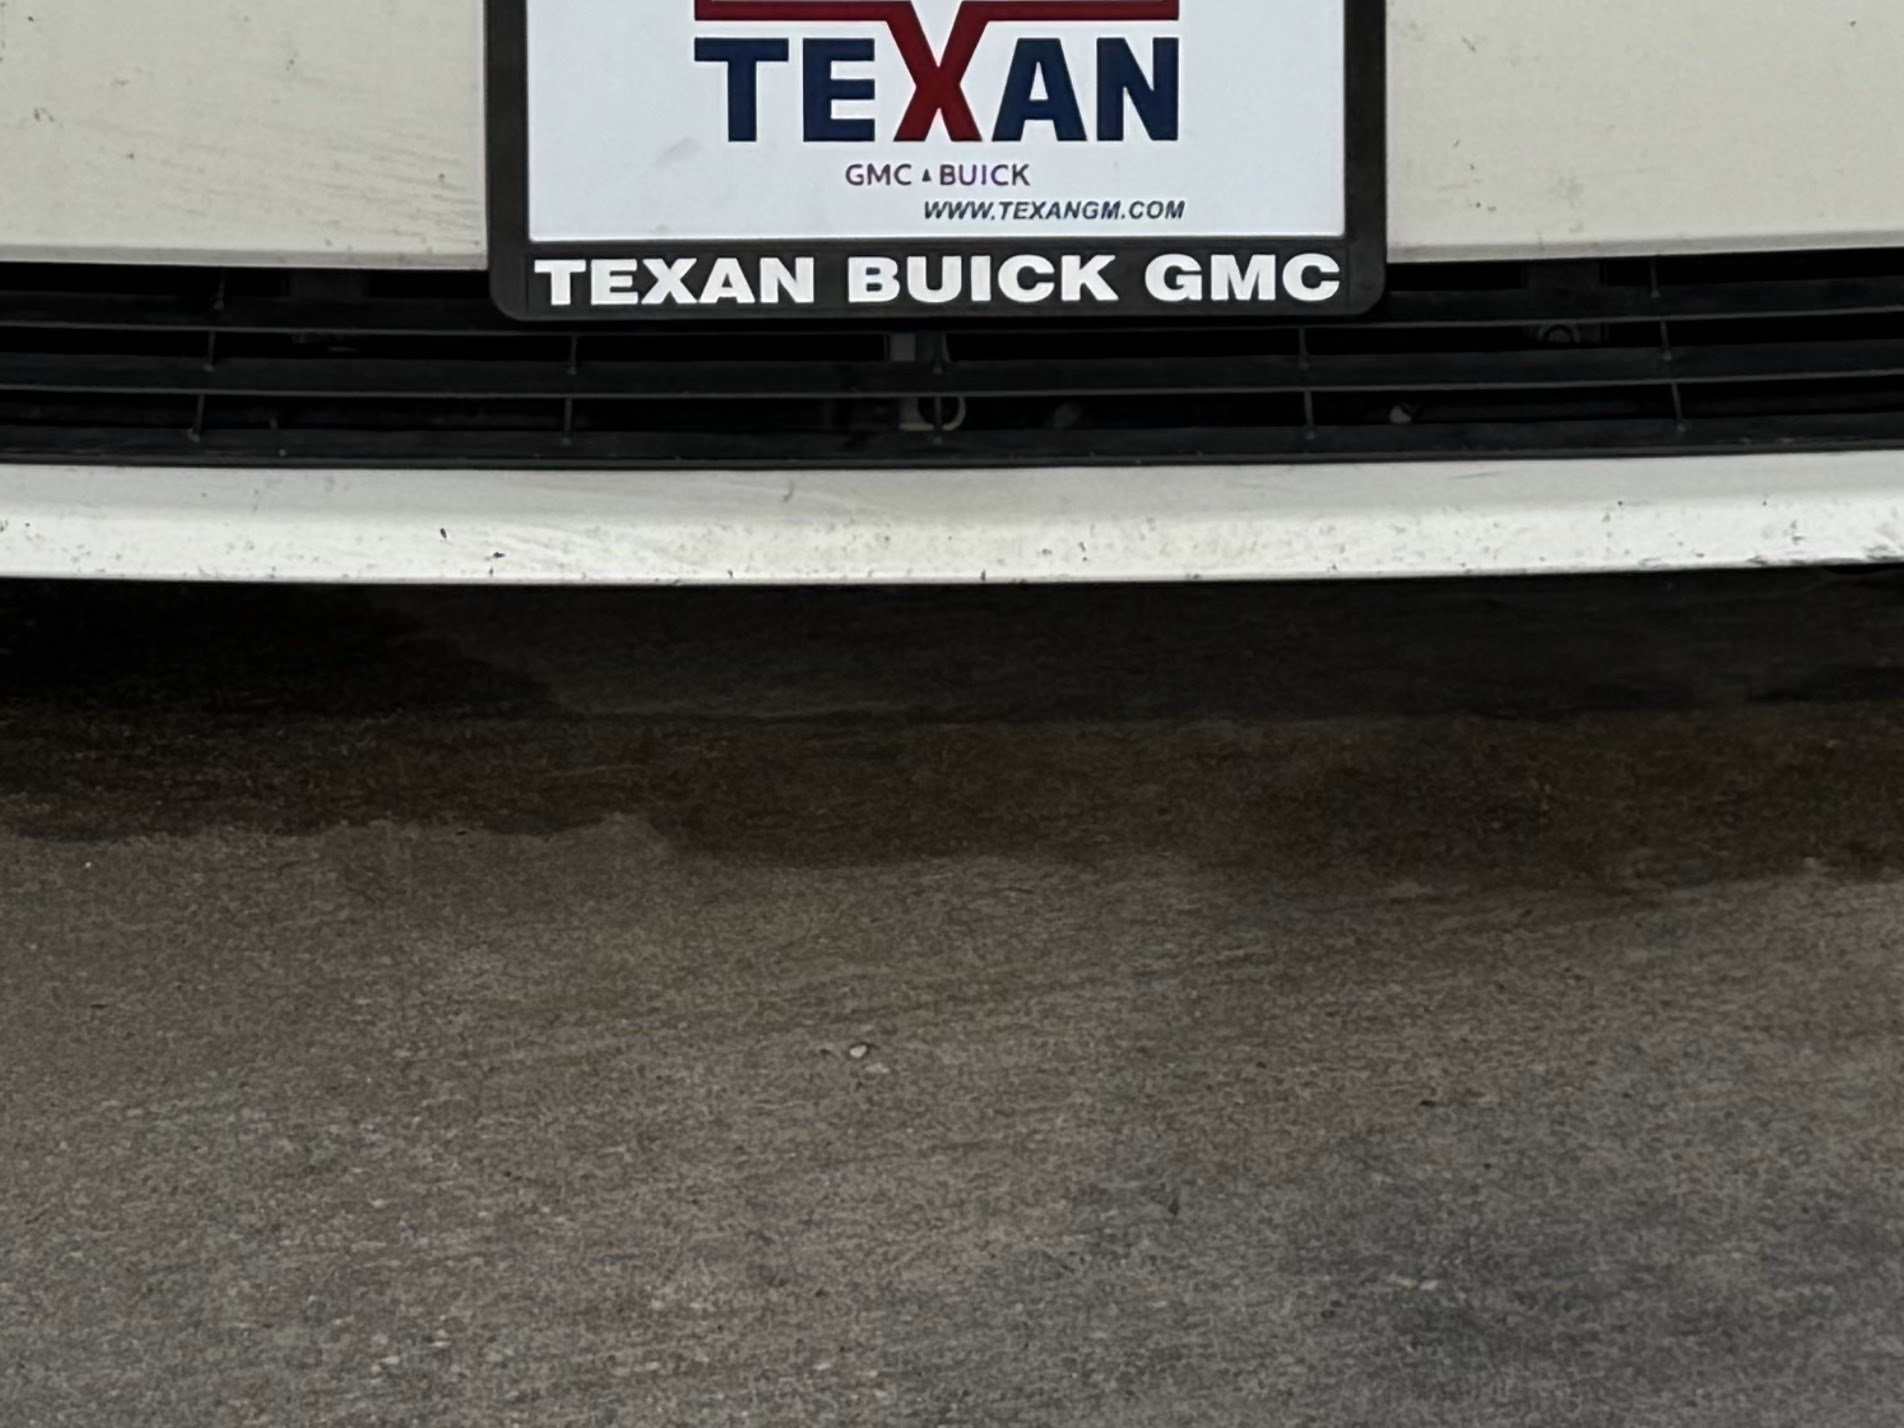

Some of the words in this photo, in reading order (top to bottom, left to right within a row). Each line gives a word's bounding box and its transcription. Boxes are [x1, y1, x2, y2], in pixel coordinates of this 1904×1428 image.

[694, 0, 1180, 143] TEXAN
[845, 163, 913, 187] GMC
[939, 163, 1031, 187] BUICK
[923, 200, 1186, 221] WWW.TEXANGM.COM
[534, 257, 815, 305] TEXAN
[848, 255, 1120, 305] BUICK
[1144, 253, 1342, 304] GMC
